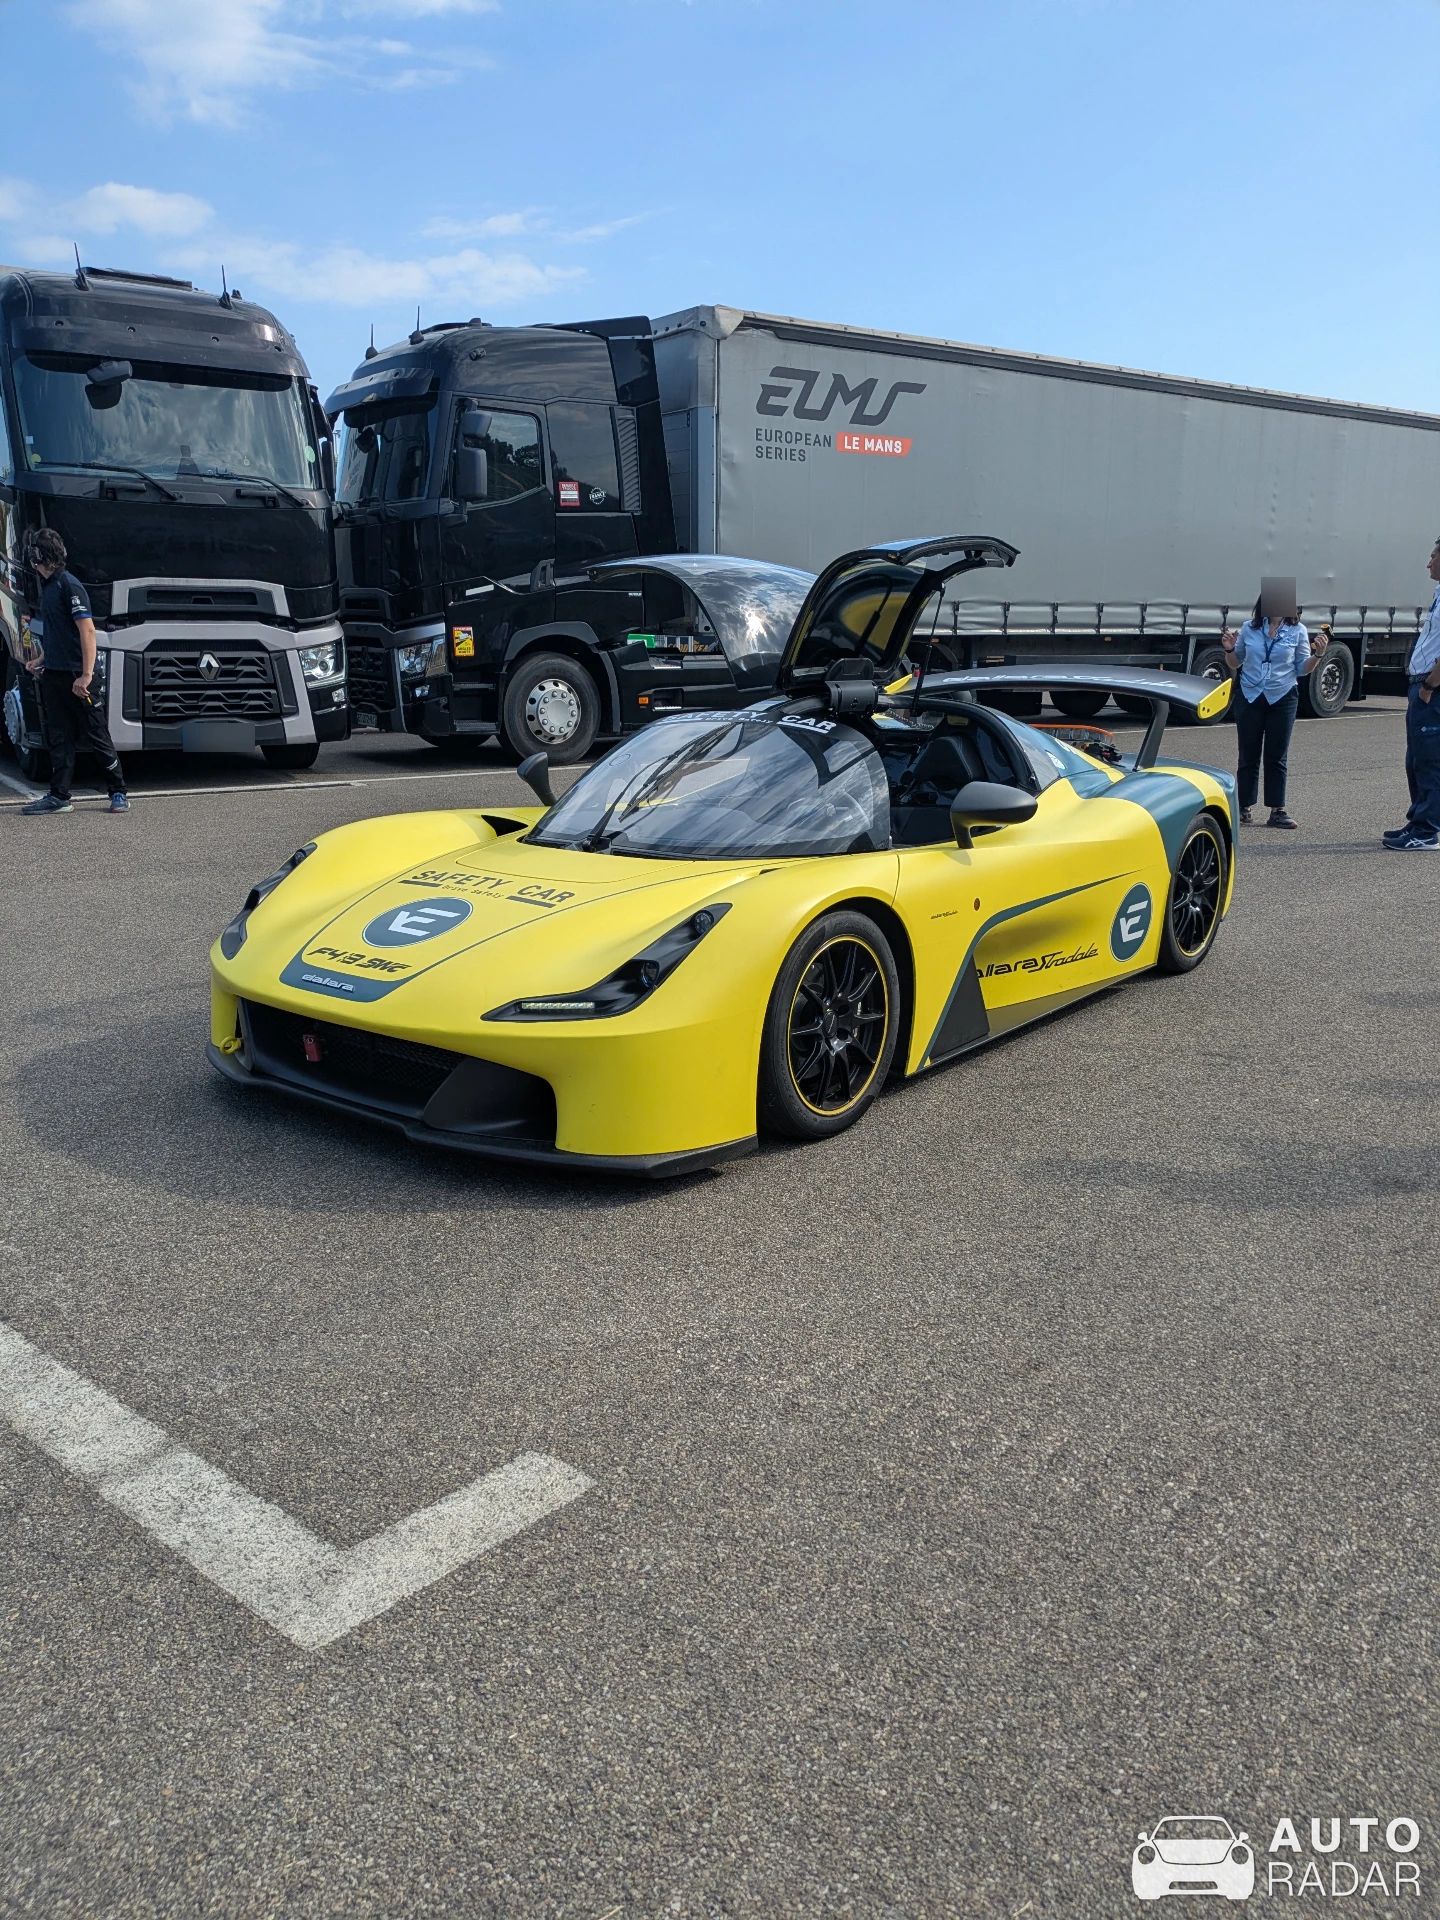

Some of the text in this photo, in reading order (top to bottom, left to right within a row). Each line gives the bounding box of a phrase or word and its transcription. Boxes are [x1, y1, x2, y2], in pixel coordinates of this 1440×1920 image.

[756, 366, 927, 426] ELMS
[755, 428, 902, 453] EUROPEAN LE MANS
[755, 446, 806, 462] SERIES
[662, 711, 837, 731] SAFETY CAR
[411, 870, 576, 903] SAFETY CAR
